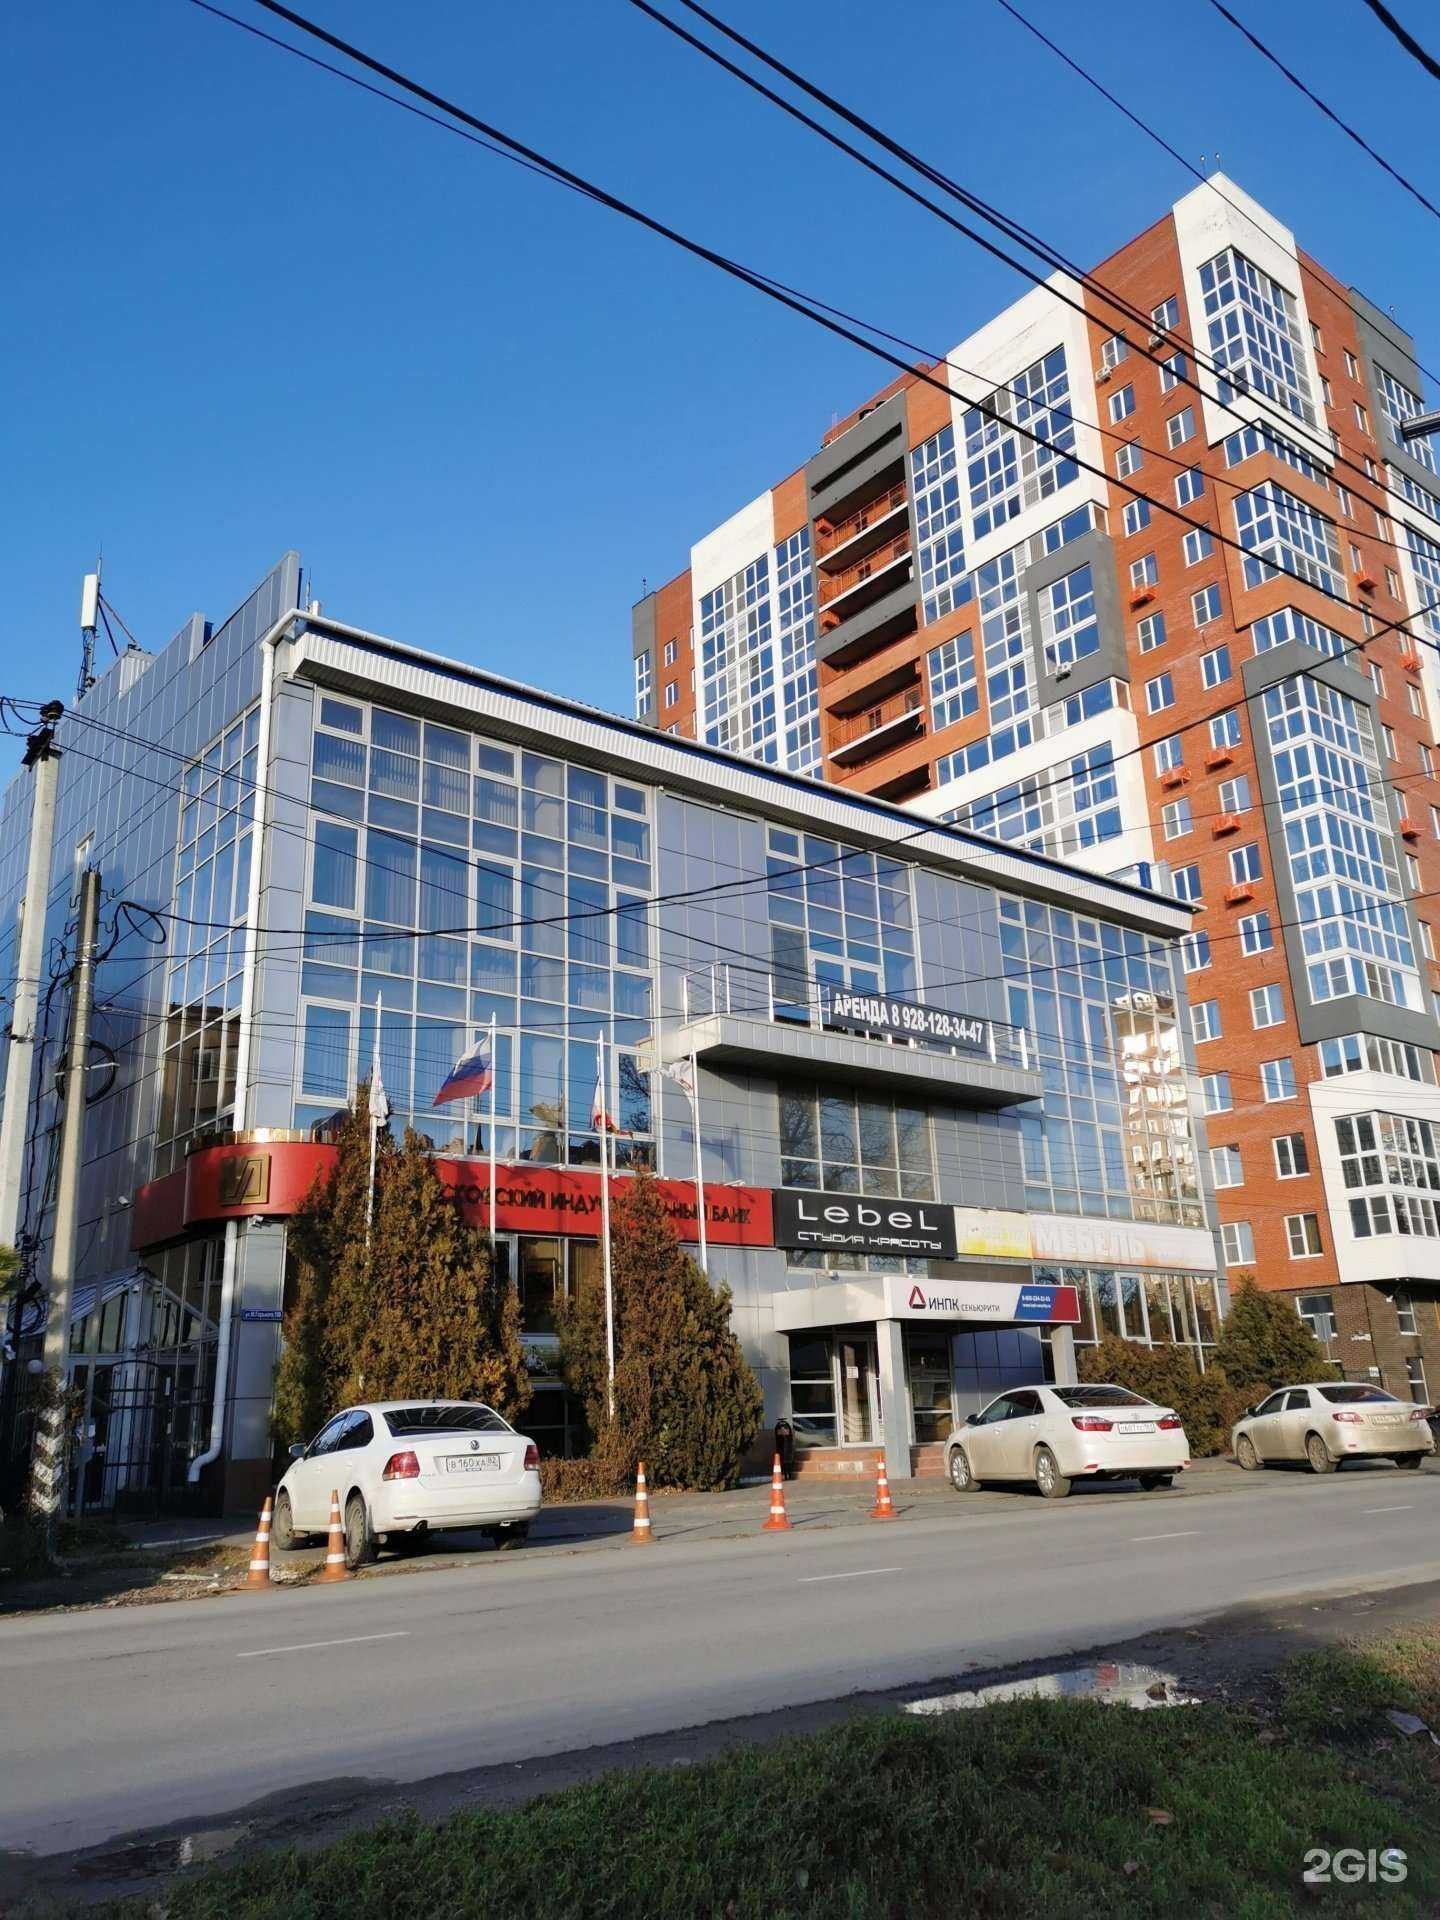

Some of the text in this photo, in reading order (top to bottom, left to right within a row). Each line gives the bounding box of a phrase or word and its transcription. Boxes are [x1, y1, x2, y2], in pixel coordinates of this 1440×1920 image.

[834, 993, 983, 1043] АРЕНДА 8 928-128-34-47
[712, 1205, 751, 1224] БАНК
[798, 1231, 941, 1250] СТУДИЯ КРАСОТЫ
[928, 1297, 1000, 1313] ИНПК СЕКЬЮРИТИ
